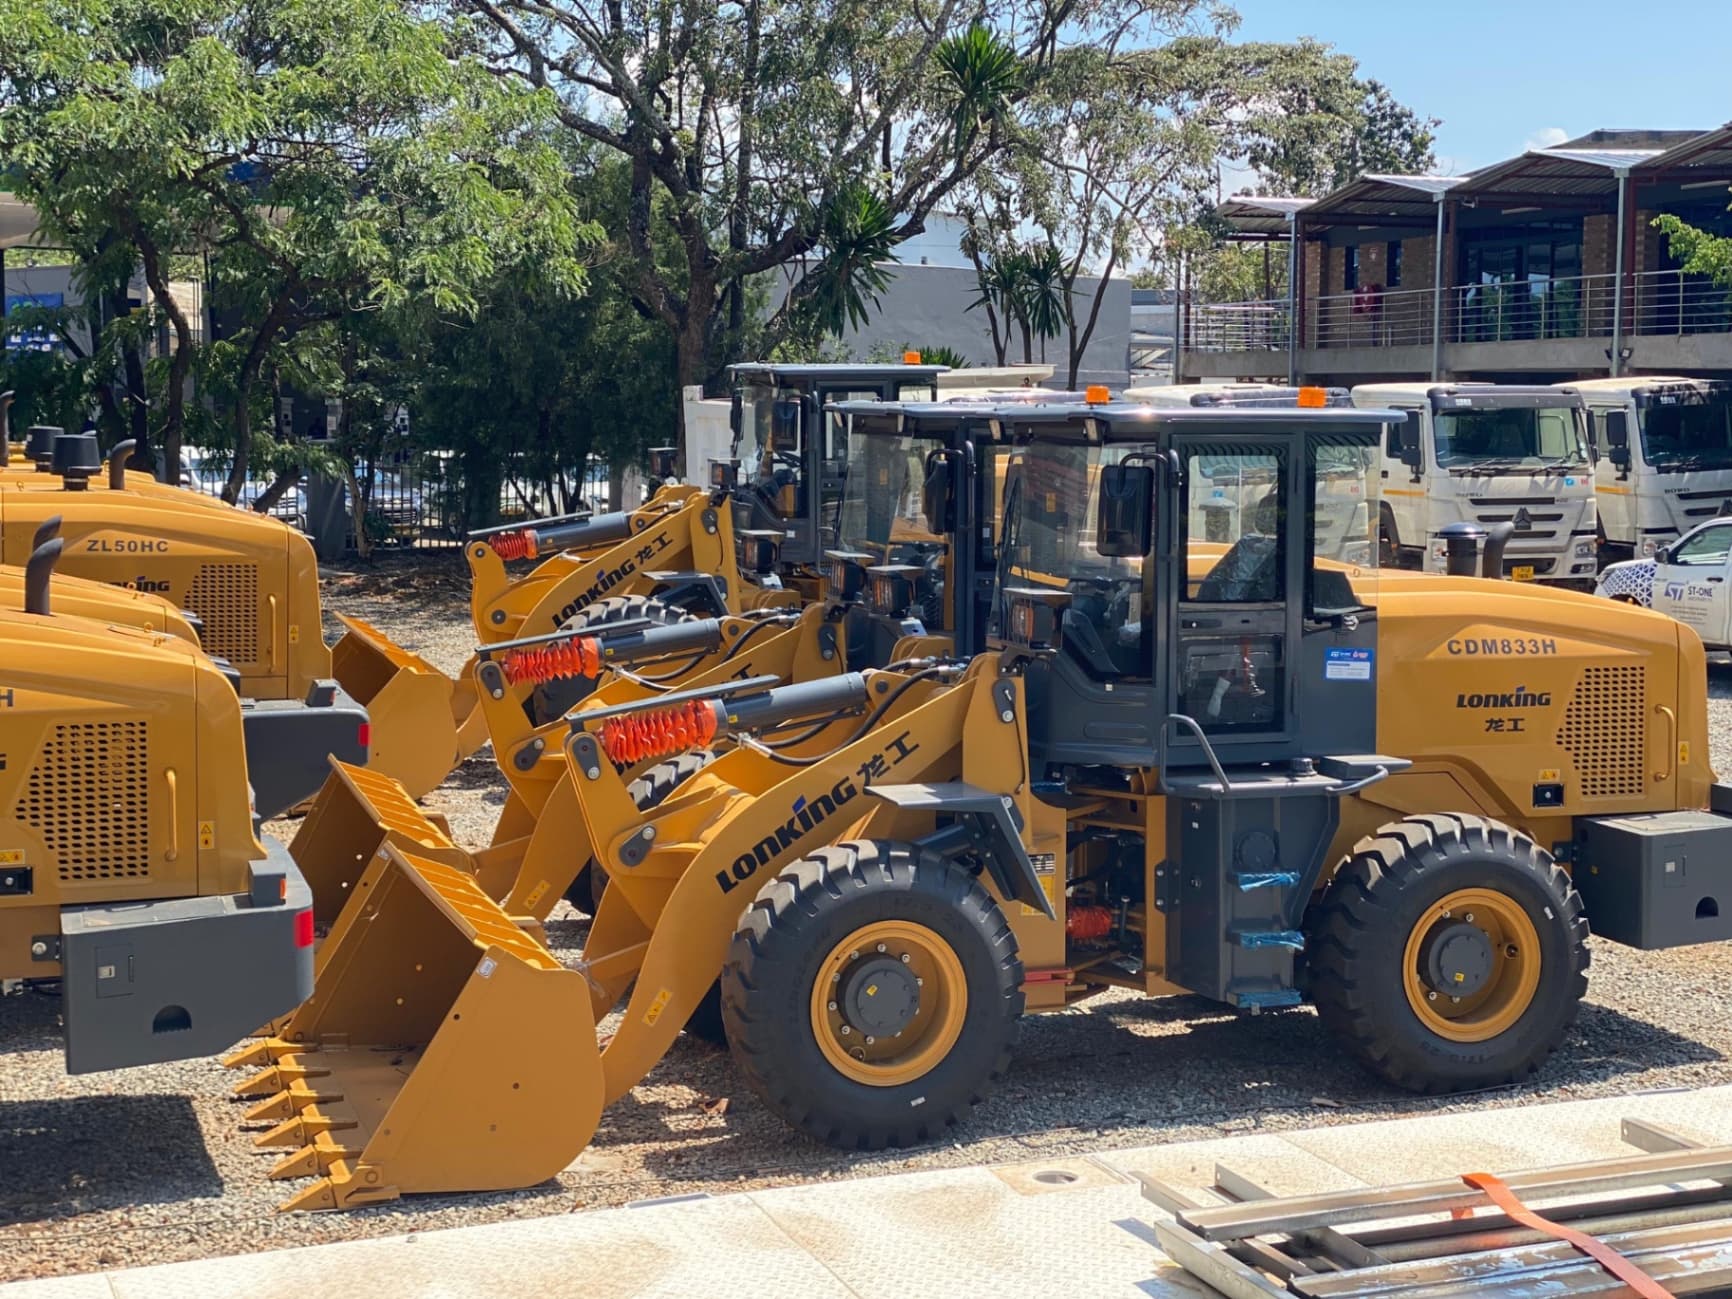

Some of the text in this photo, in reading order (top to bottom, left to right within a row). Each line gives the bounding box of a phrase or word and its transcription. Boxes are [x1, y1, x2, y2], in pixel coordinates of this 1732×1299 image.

[86, 540, 169, 552] ZL50HC
[1447, 639, 1556, 655] CDM833H
[1484, 718, 1526, 732] 龙工
[856, 731, 920, 790] 龙工
